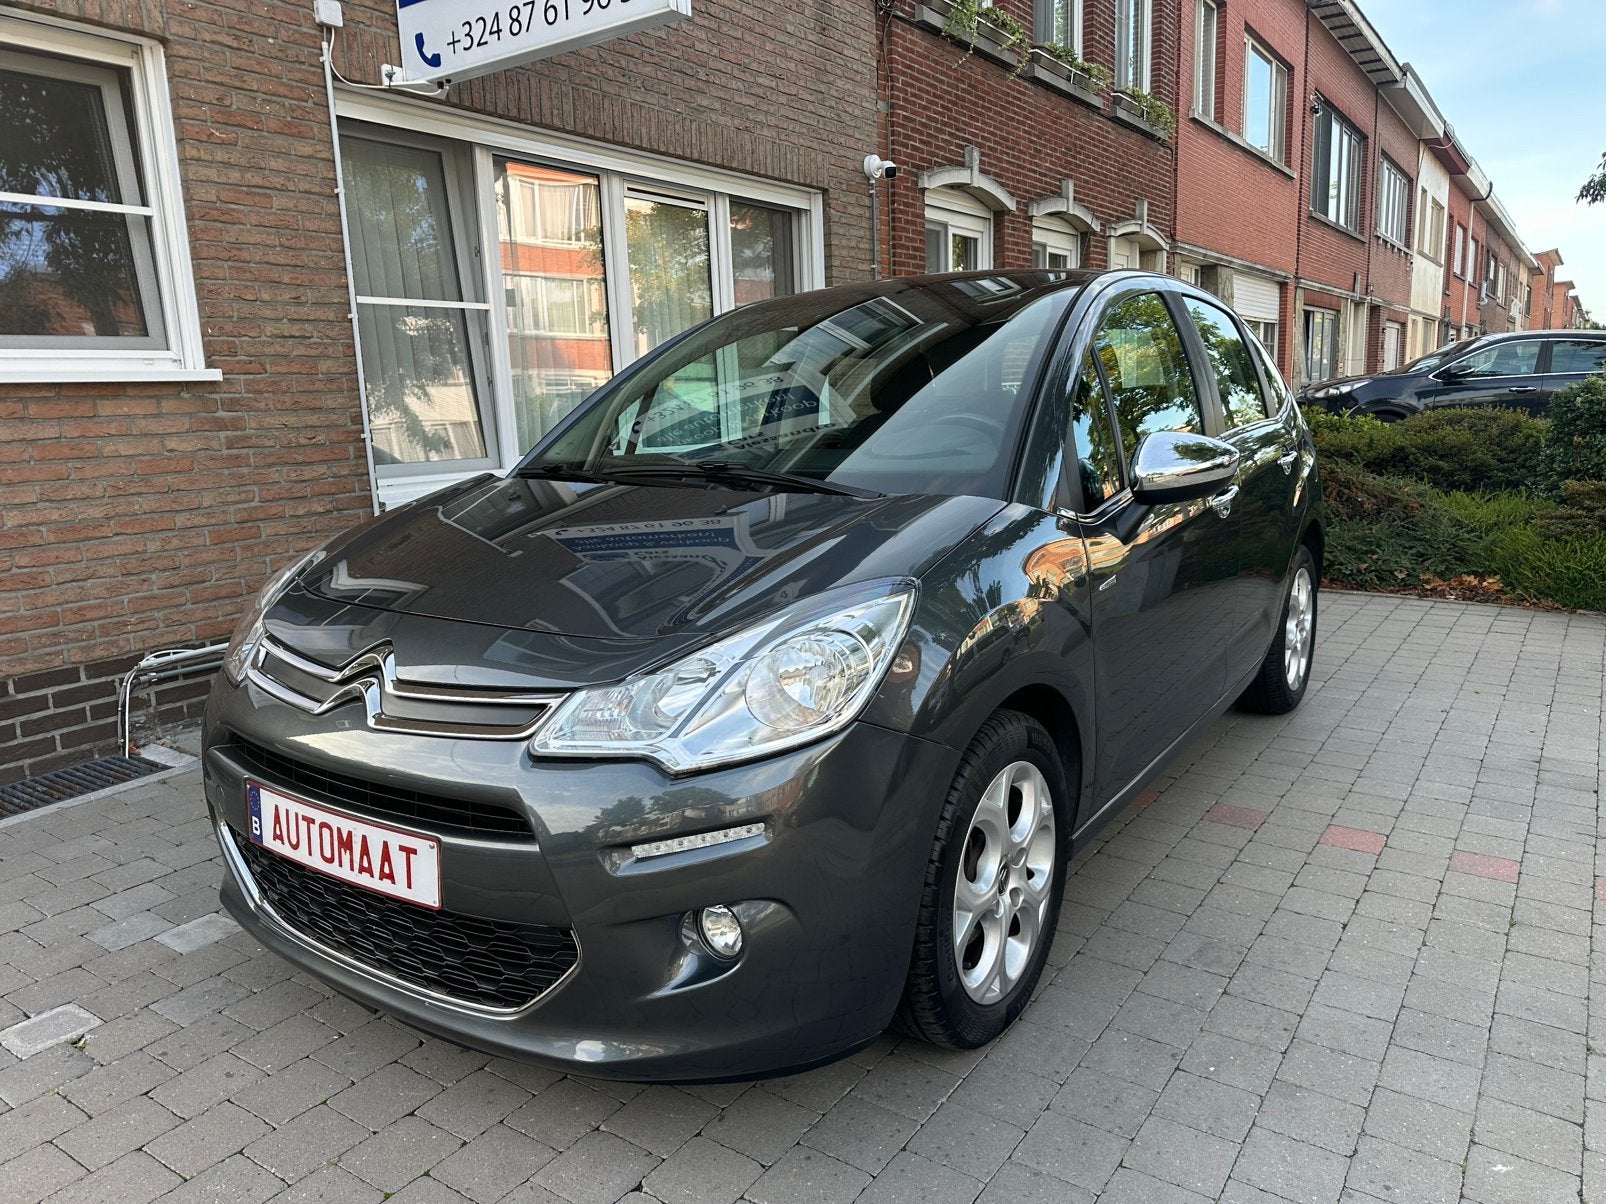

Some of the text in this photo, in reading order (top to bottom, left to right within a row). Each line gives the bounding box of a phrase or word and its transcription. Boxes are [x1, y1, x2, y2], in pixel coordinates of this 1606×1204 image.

[446, 11, 503, 55] +324
[508, 1, 536, 37] 87
[251, 815, 261, 836] B
[272, 803, 418, 890] AUTOMAAT
